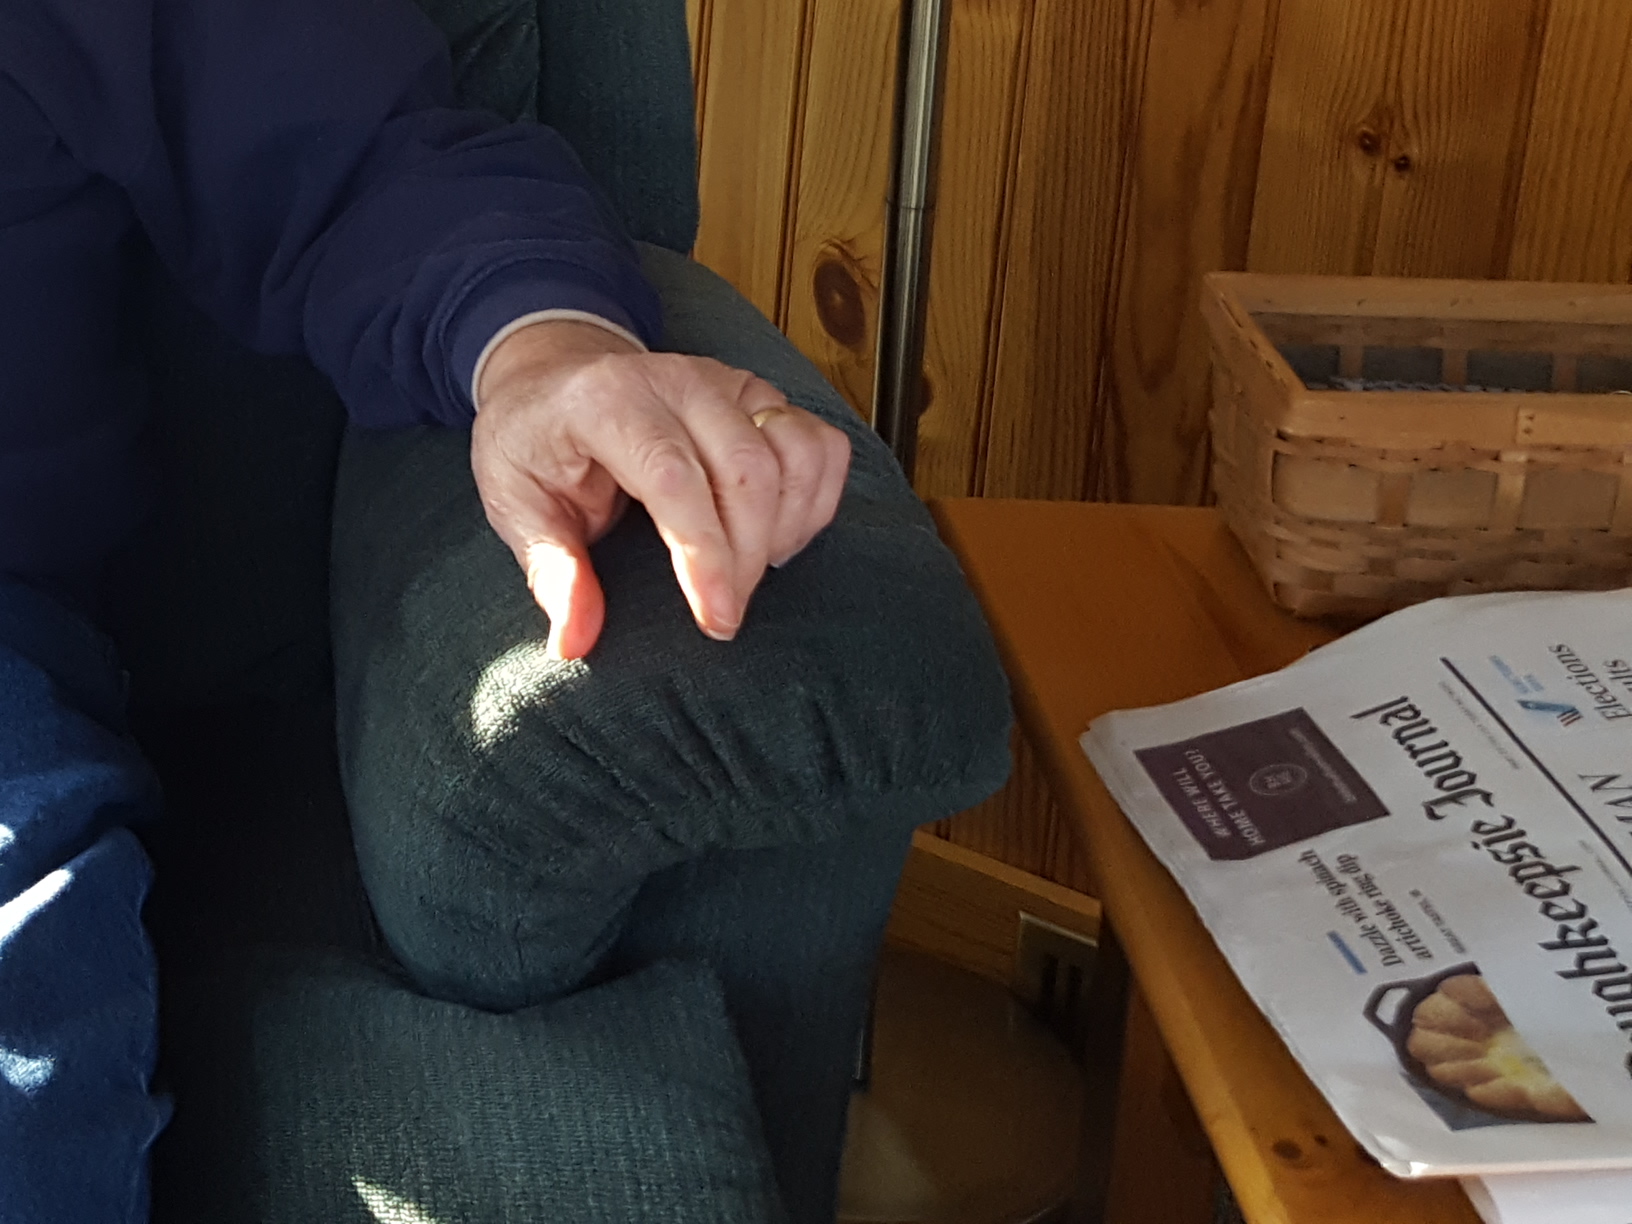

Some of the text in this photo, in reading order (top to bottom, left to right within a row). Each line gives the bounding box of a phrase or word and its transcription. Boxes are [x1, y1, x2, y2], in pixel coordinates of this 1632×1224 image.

[1548, 643, 1632, 721] Elections
[1173, 767, 1199, 795] WILL
[1350, 695, 1495, 821] Journal
[1185, 748, 1266, 847] HOME TAKE YOU?
[1298, 849, 1347, 896] spinach
[1335, 853, 1433, 960] artichoke ring dip
[1335, 897, 1368, 923] with
[1360, 925, 1404, 966] Dazzle
